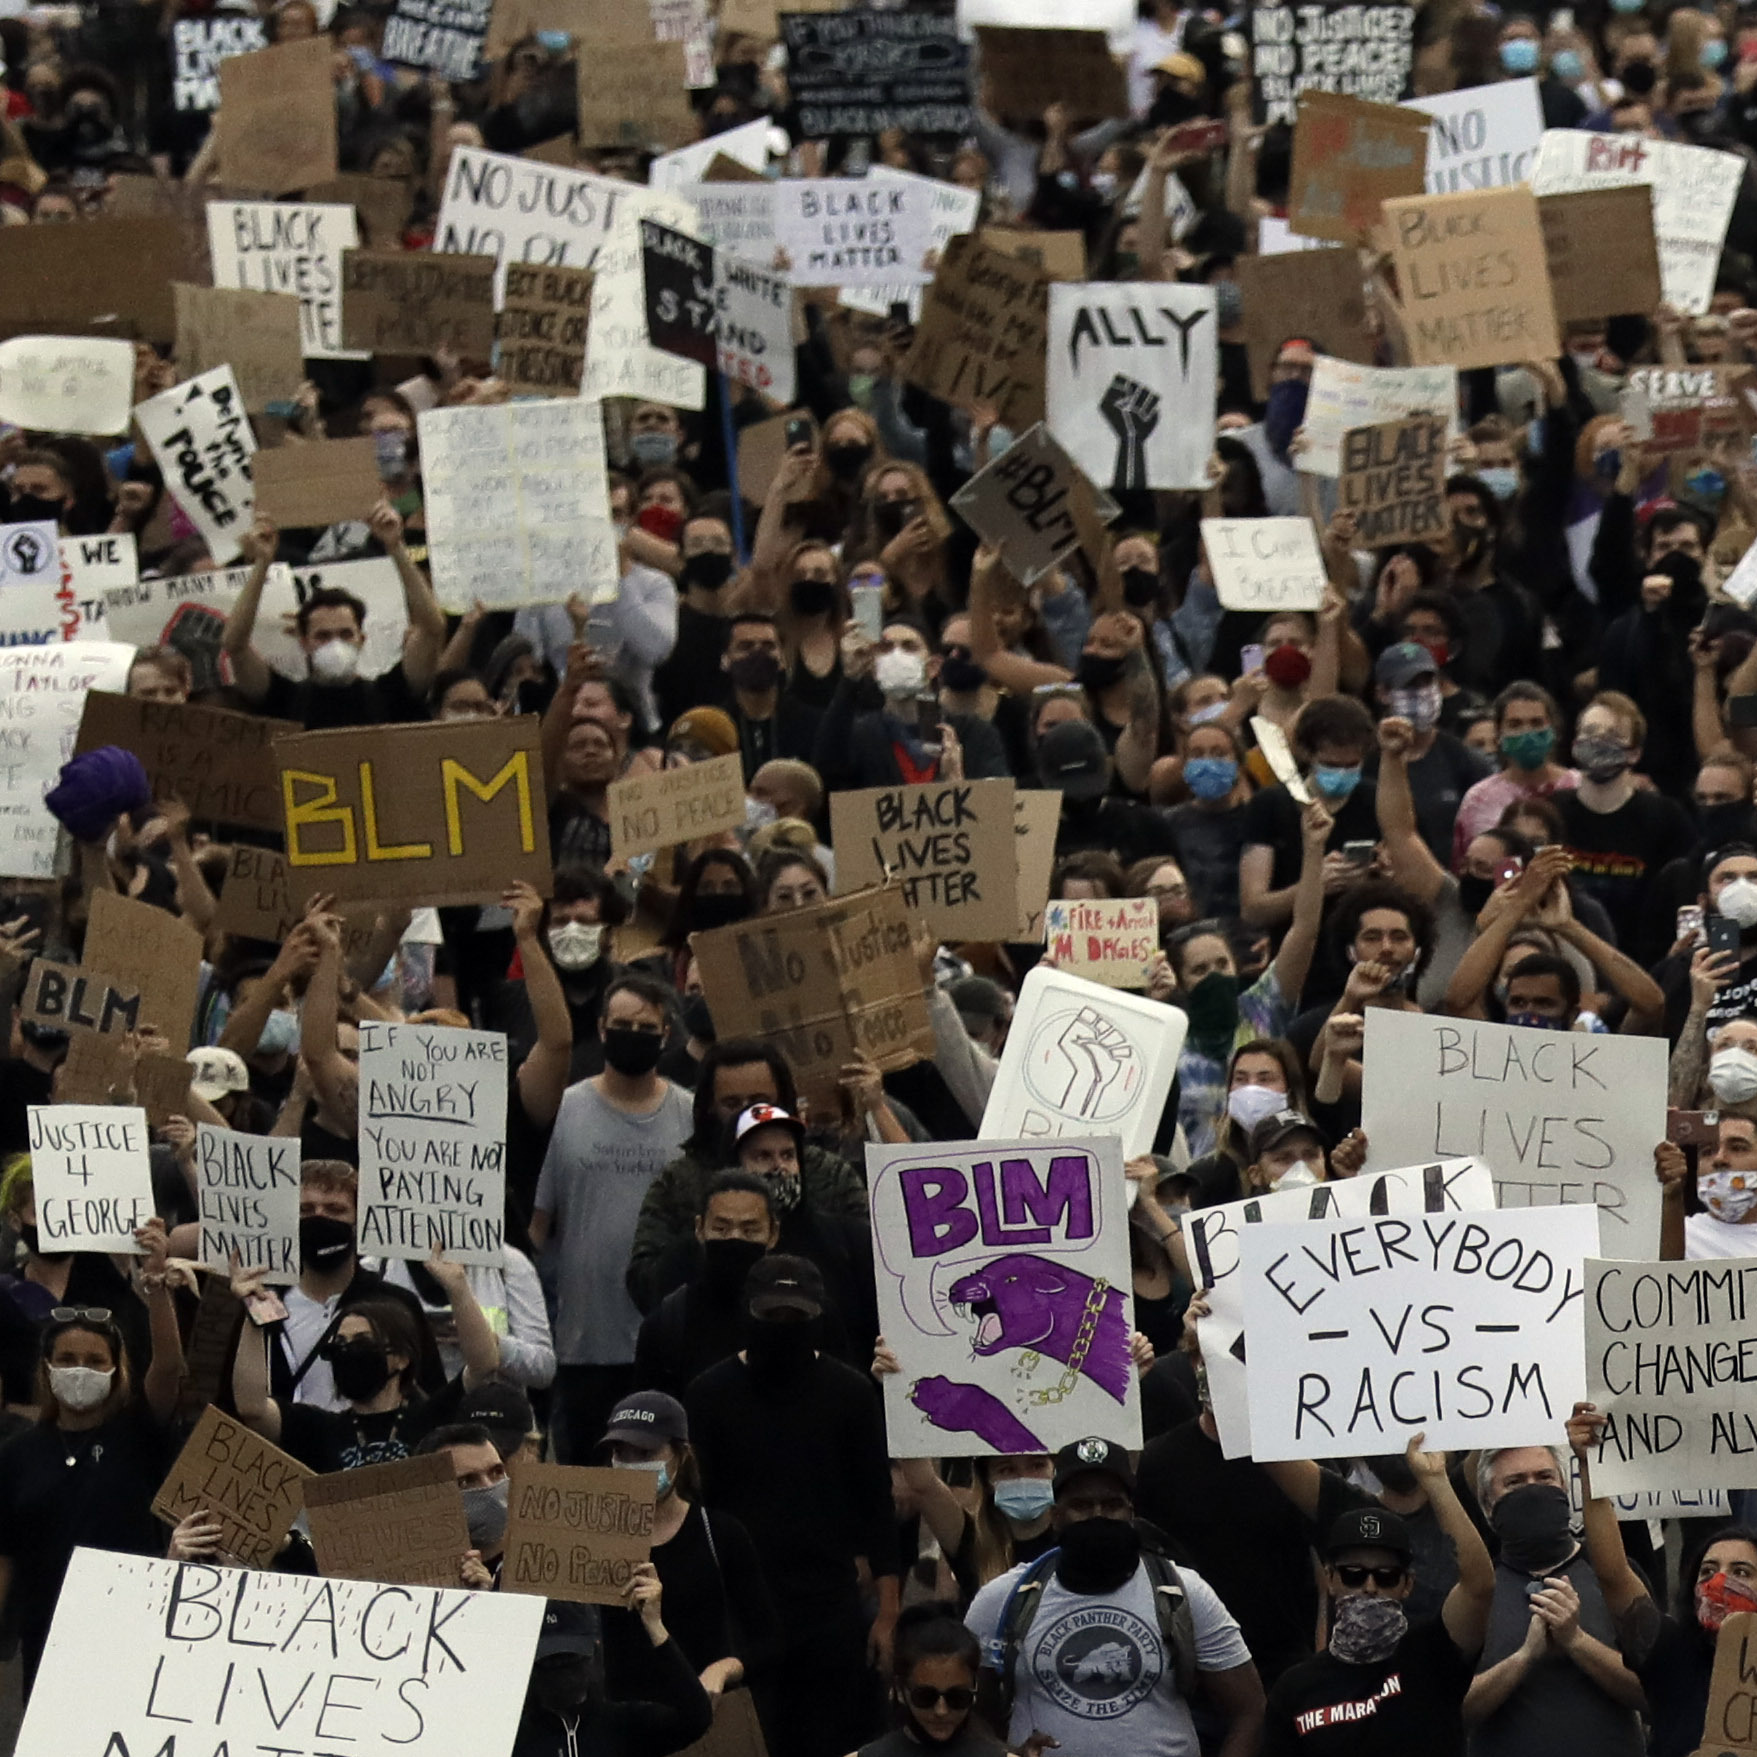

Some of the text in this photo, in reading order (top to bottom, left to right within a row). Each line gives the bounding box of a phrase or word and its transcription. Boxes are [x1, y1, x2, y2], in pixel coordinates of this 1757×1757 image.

[450, 154, 509, 208] NO
[800, 189, 907, 217] BLACK
[808, 248, 900, 271] MATTER
[823, 221, 894, 246] LIVES
[1409, 248, 1518, 298] LIVES
[1068, 306, 1210, 381] ALLY
[1416, 308, 1535, 353] MATTER
[281, 750, 536, 868] BLM
[898, 1151, 1095, 1259] BLM
[1262, 1217, 1586, 1324] EVERYBODY
[1293, 1359, 1554, 1442] RACISM
[1597, 1411, 1684, 1466] AND
[164, 1561, 471, 1675] BLACK
[1039, 1611, 1159, 1657] BLACK PANTHER PARTY
[143, 1655, 429, 1746] LIVES
[1039, 1669, 1158, 1717] SEIZE THE TIME
